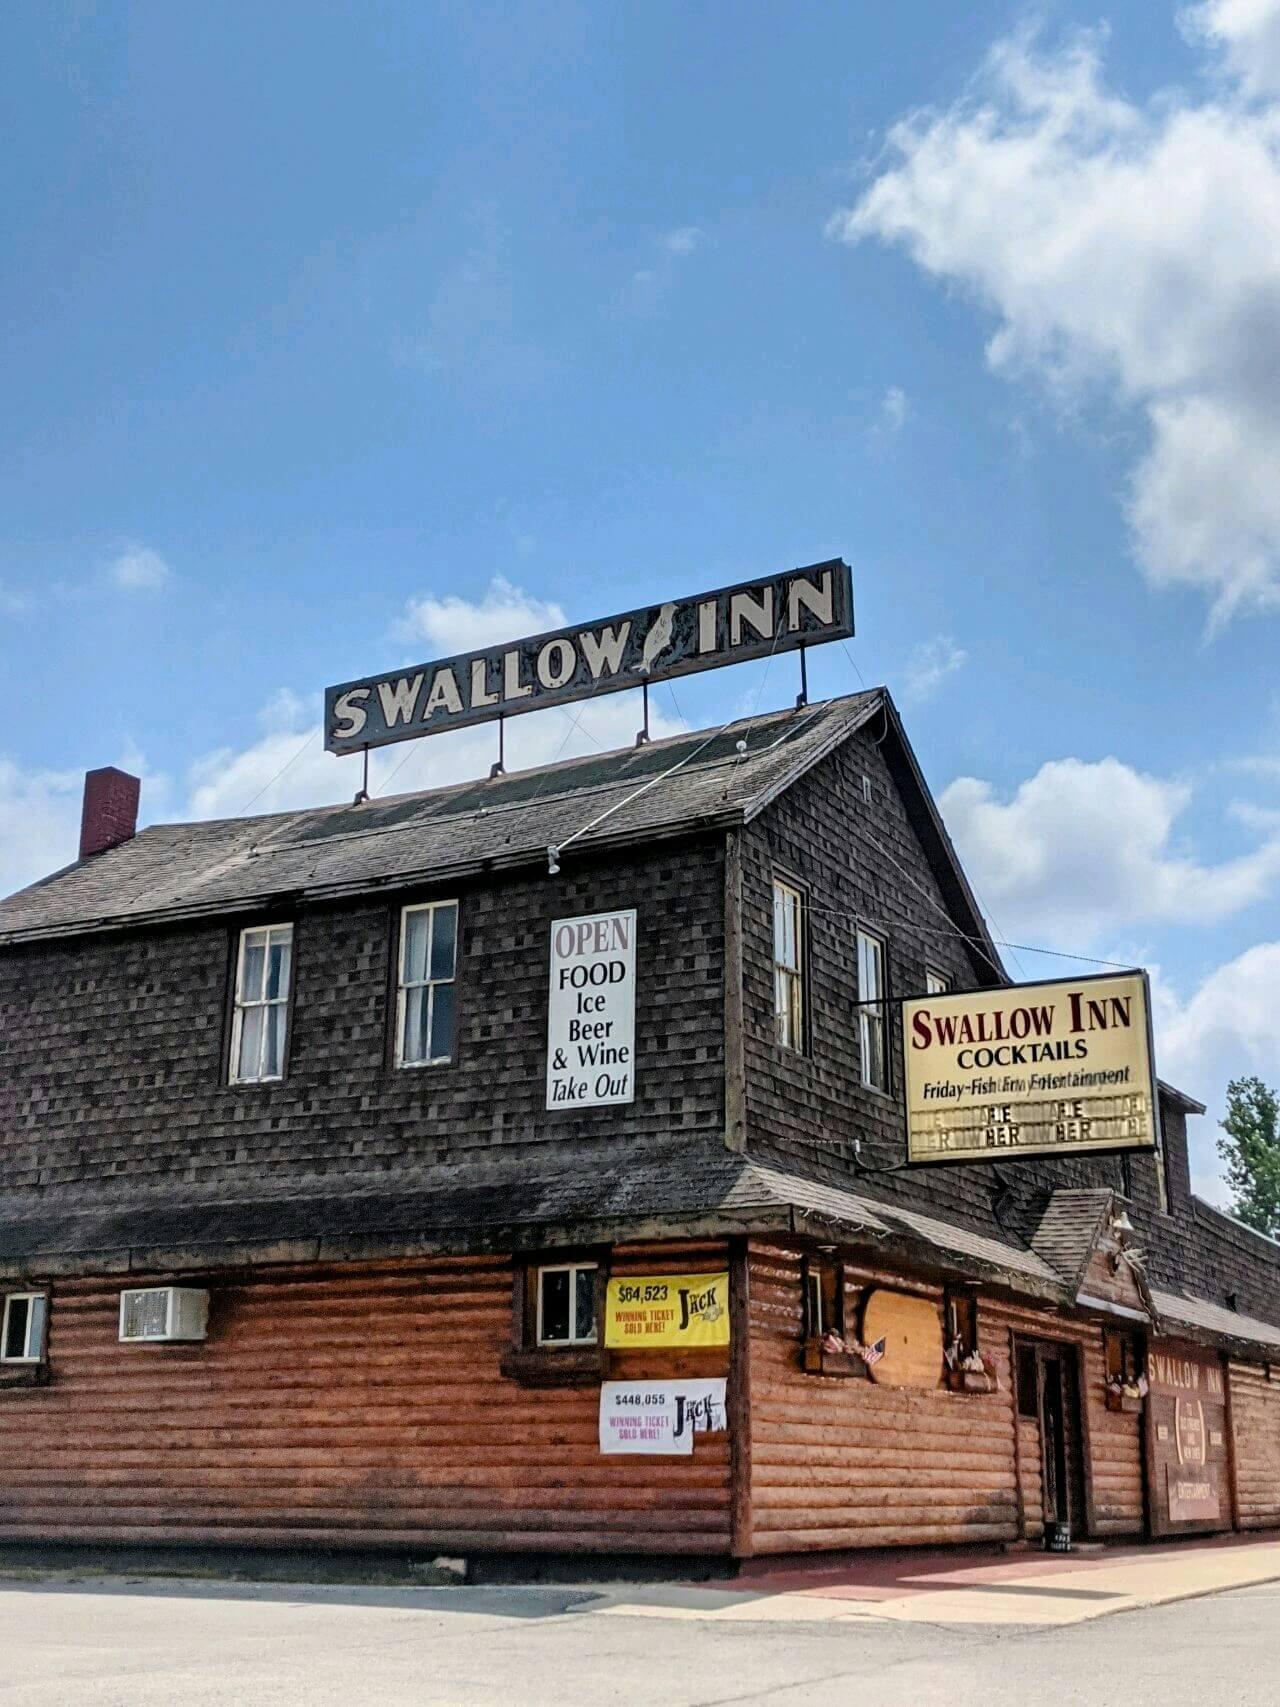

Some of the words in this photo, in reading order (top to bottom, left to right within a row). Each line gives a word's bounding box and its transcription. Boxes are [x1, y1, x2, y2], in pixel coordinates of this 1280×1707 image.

[332, 621, 632, 740] SWALLOW
[699, 570, 834, 654] INN
[555, 916, 631, 959] OPEN
[559, 960, 626, 990] FOOD
[577, 992, 606, 1014] Ice
[569, 1019, 614, 1042] Beer
[912, 1005, 1056, 1050] SWALLOW
[1067, 992, 1132, 1034] INN
[552, 1047, 568, 1071] &
[577, 1042, 630, 1068] Wine
[957, 1038, 1088, 1070] COCKTAILS
[552, 1076, 588, 1102] Take
[595, 1073, 628, 1098] Out
[618, 1285, 669, 1305] $64,523
[615, 1310, 648, 1322] WINNING
[650, 1309, 675, 1321] TICKET
[624, 1322, 643, 1335] SOLD
[645, 1321, 666, 1334] HERE!
[1147, 1352, 1200, 1391] SWALLOW
[615, 1394, 666, 1407] $448,055
[609, 1416, 642, 1428] WINNING
[645, 1415, 670, 1428] TICKET
[619, 1428, 638, 1441] SOLD
[640, 1428, 661, 1441] HERE!
